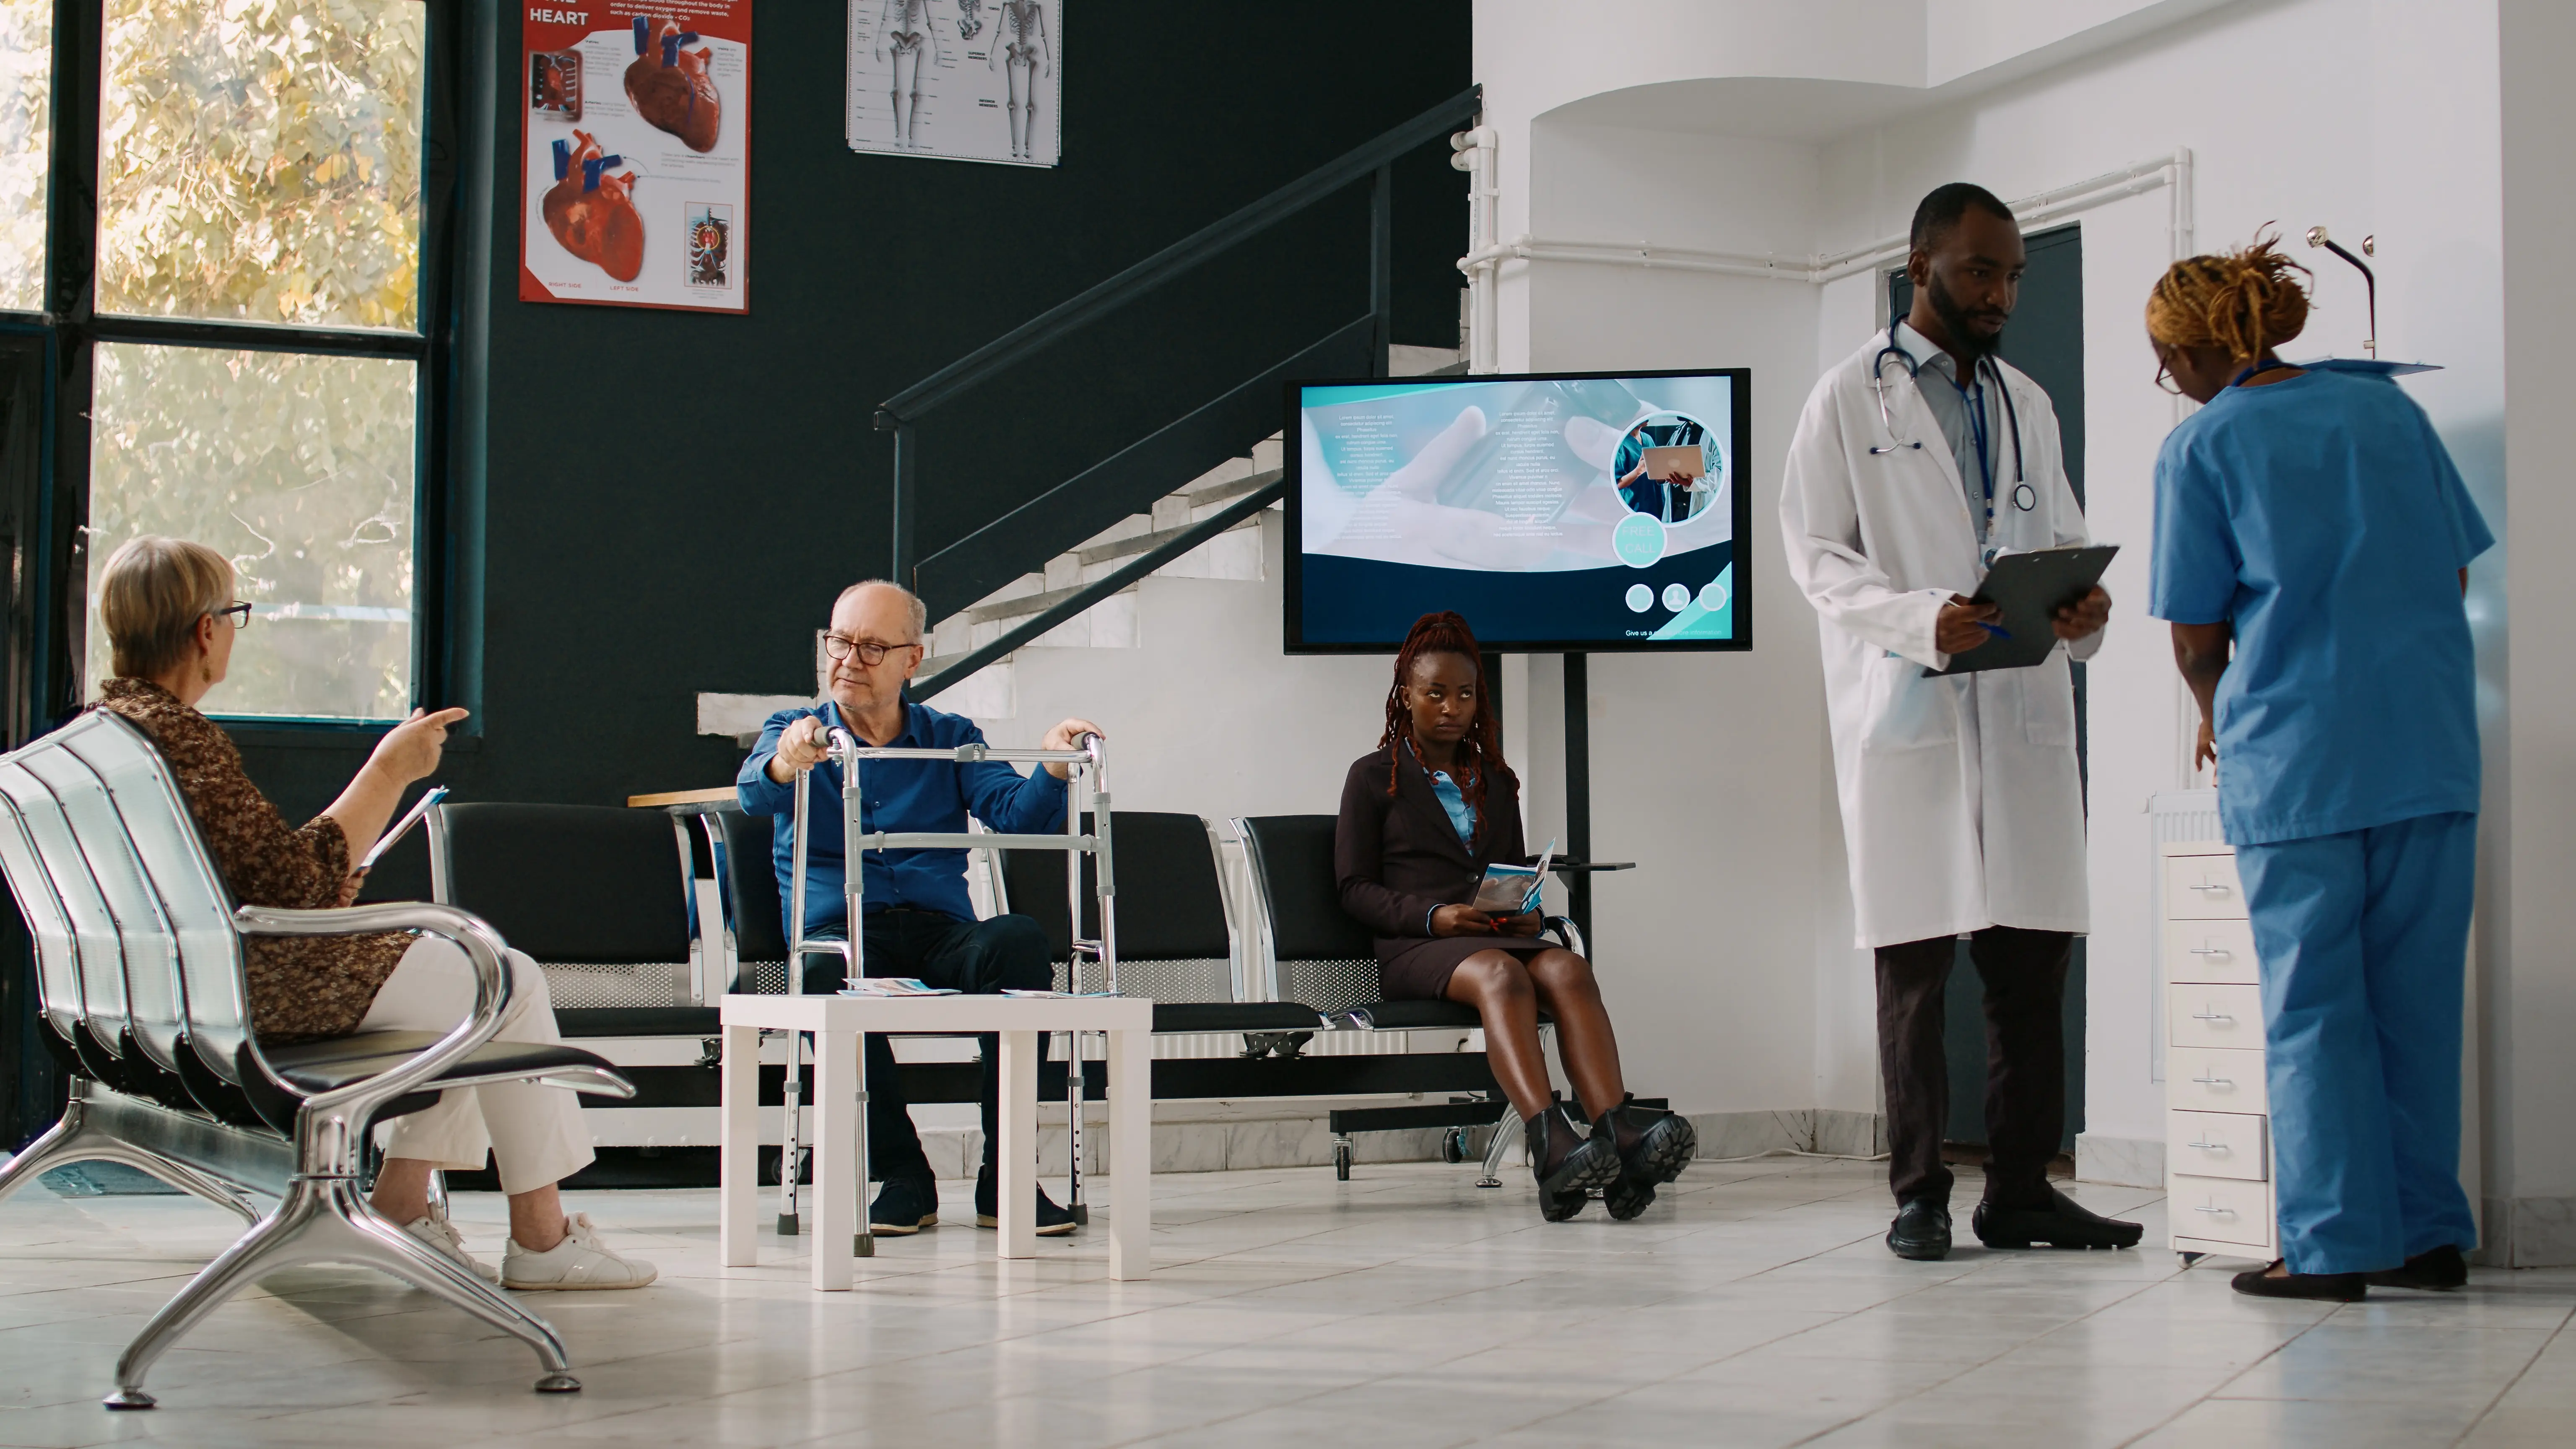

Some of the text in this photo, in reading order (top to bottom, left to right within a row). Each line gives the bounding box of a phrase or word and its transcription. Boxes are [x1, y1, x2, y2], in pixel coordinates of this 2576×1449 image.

[530, 8, 589, 25] HEART
[1622, 526, 1655, 537] FREE
[1626, 543, 1656, 553] CALL
